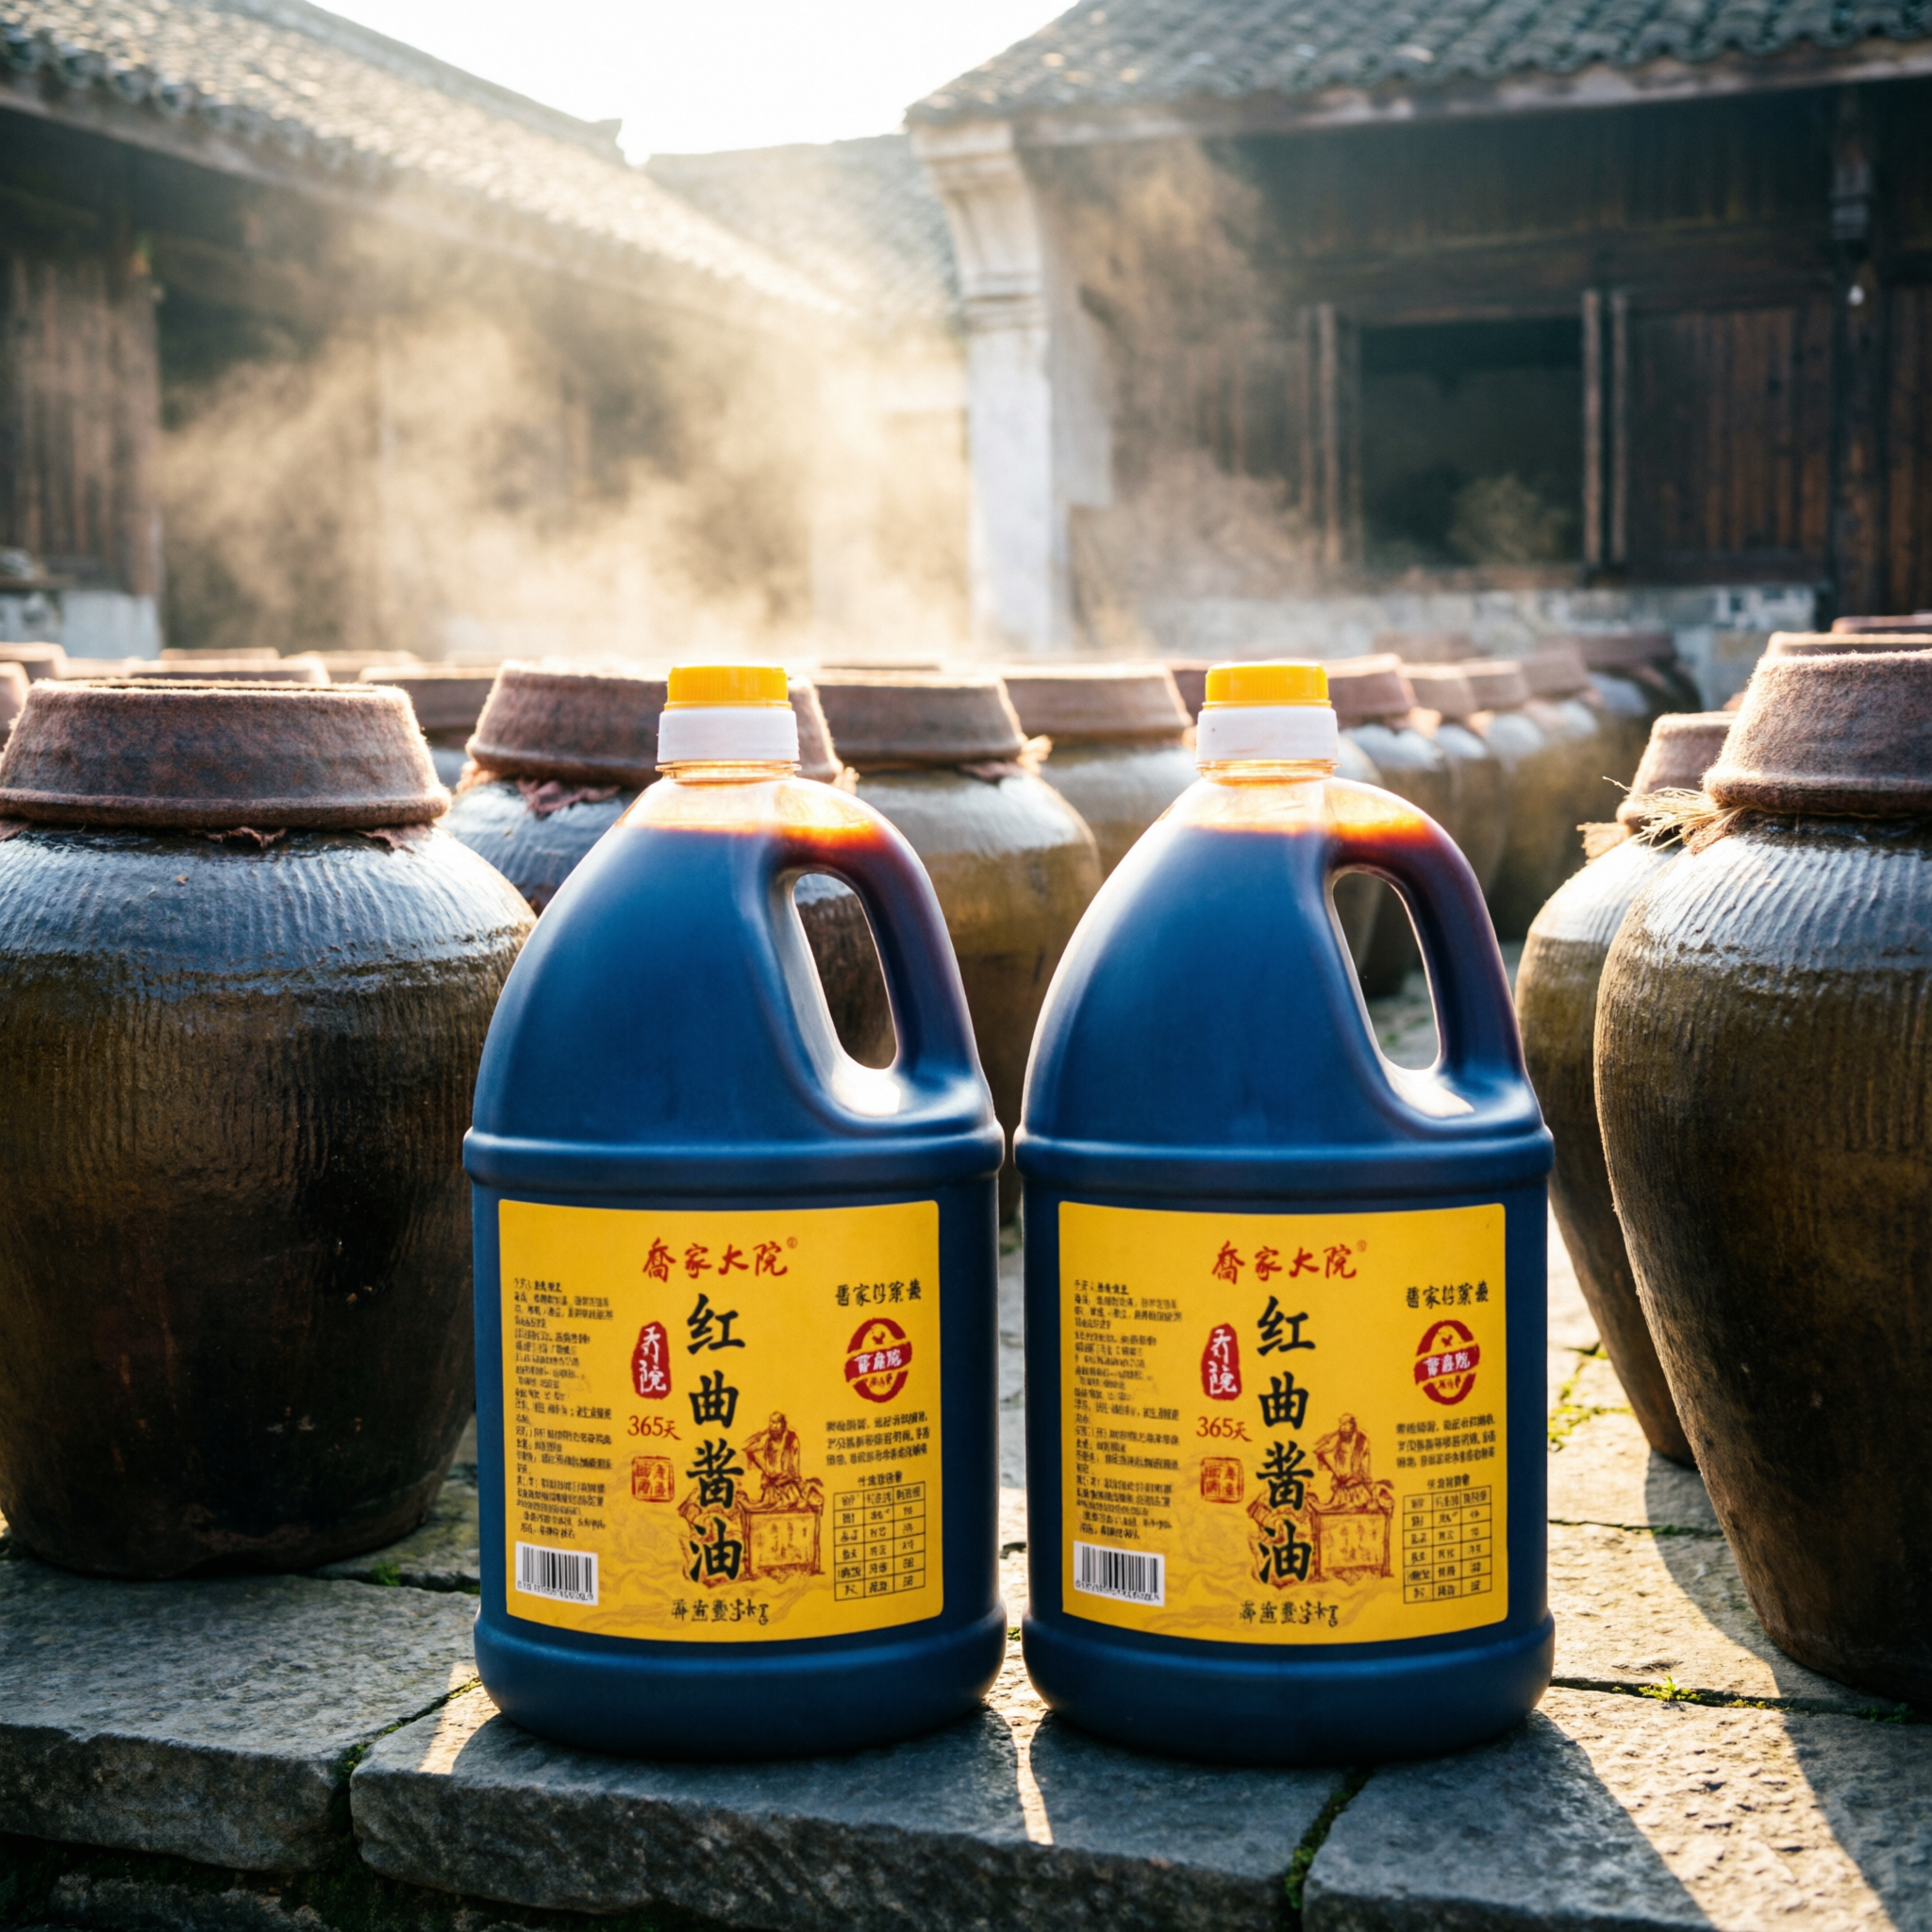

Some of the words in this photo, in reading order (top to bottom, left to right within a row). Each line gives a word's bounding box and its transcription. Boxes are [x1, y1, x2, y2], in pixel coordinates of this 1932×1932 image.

[626, 1415, 681, 1441] 365天
[686, 1293, 745, 1582] 红曲酱油
[1196, 1417, 1252, 1441] 365天
[1257, 1295, 1315, 1583] 红曲酱油
